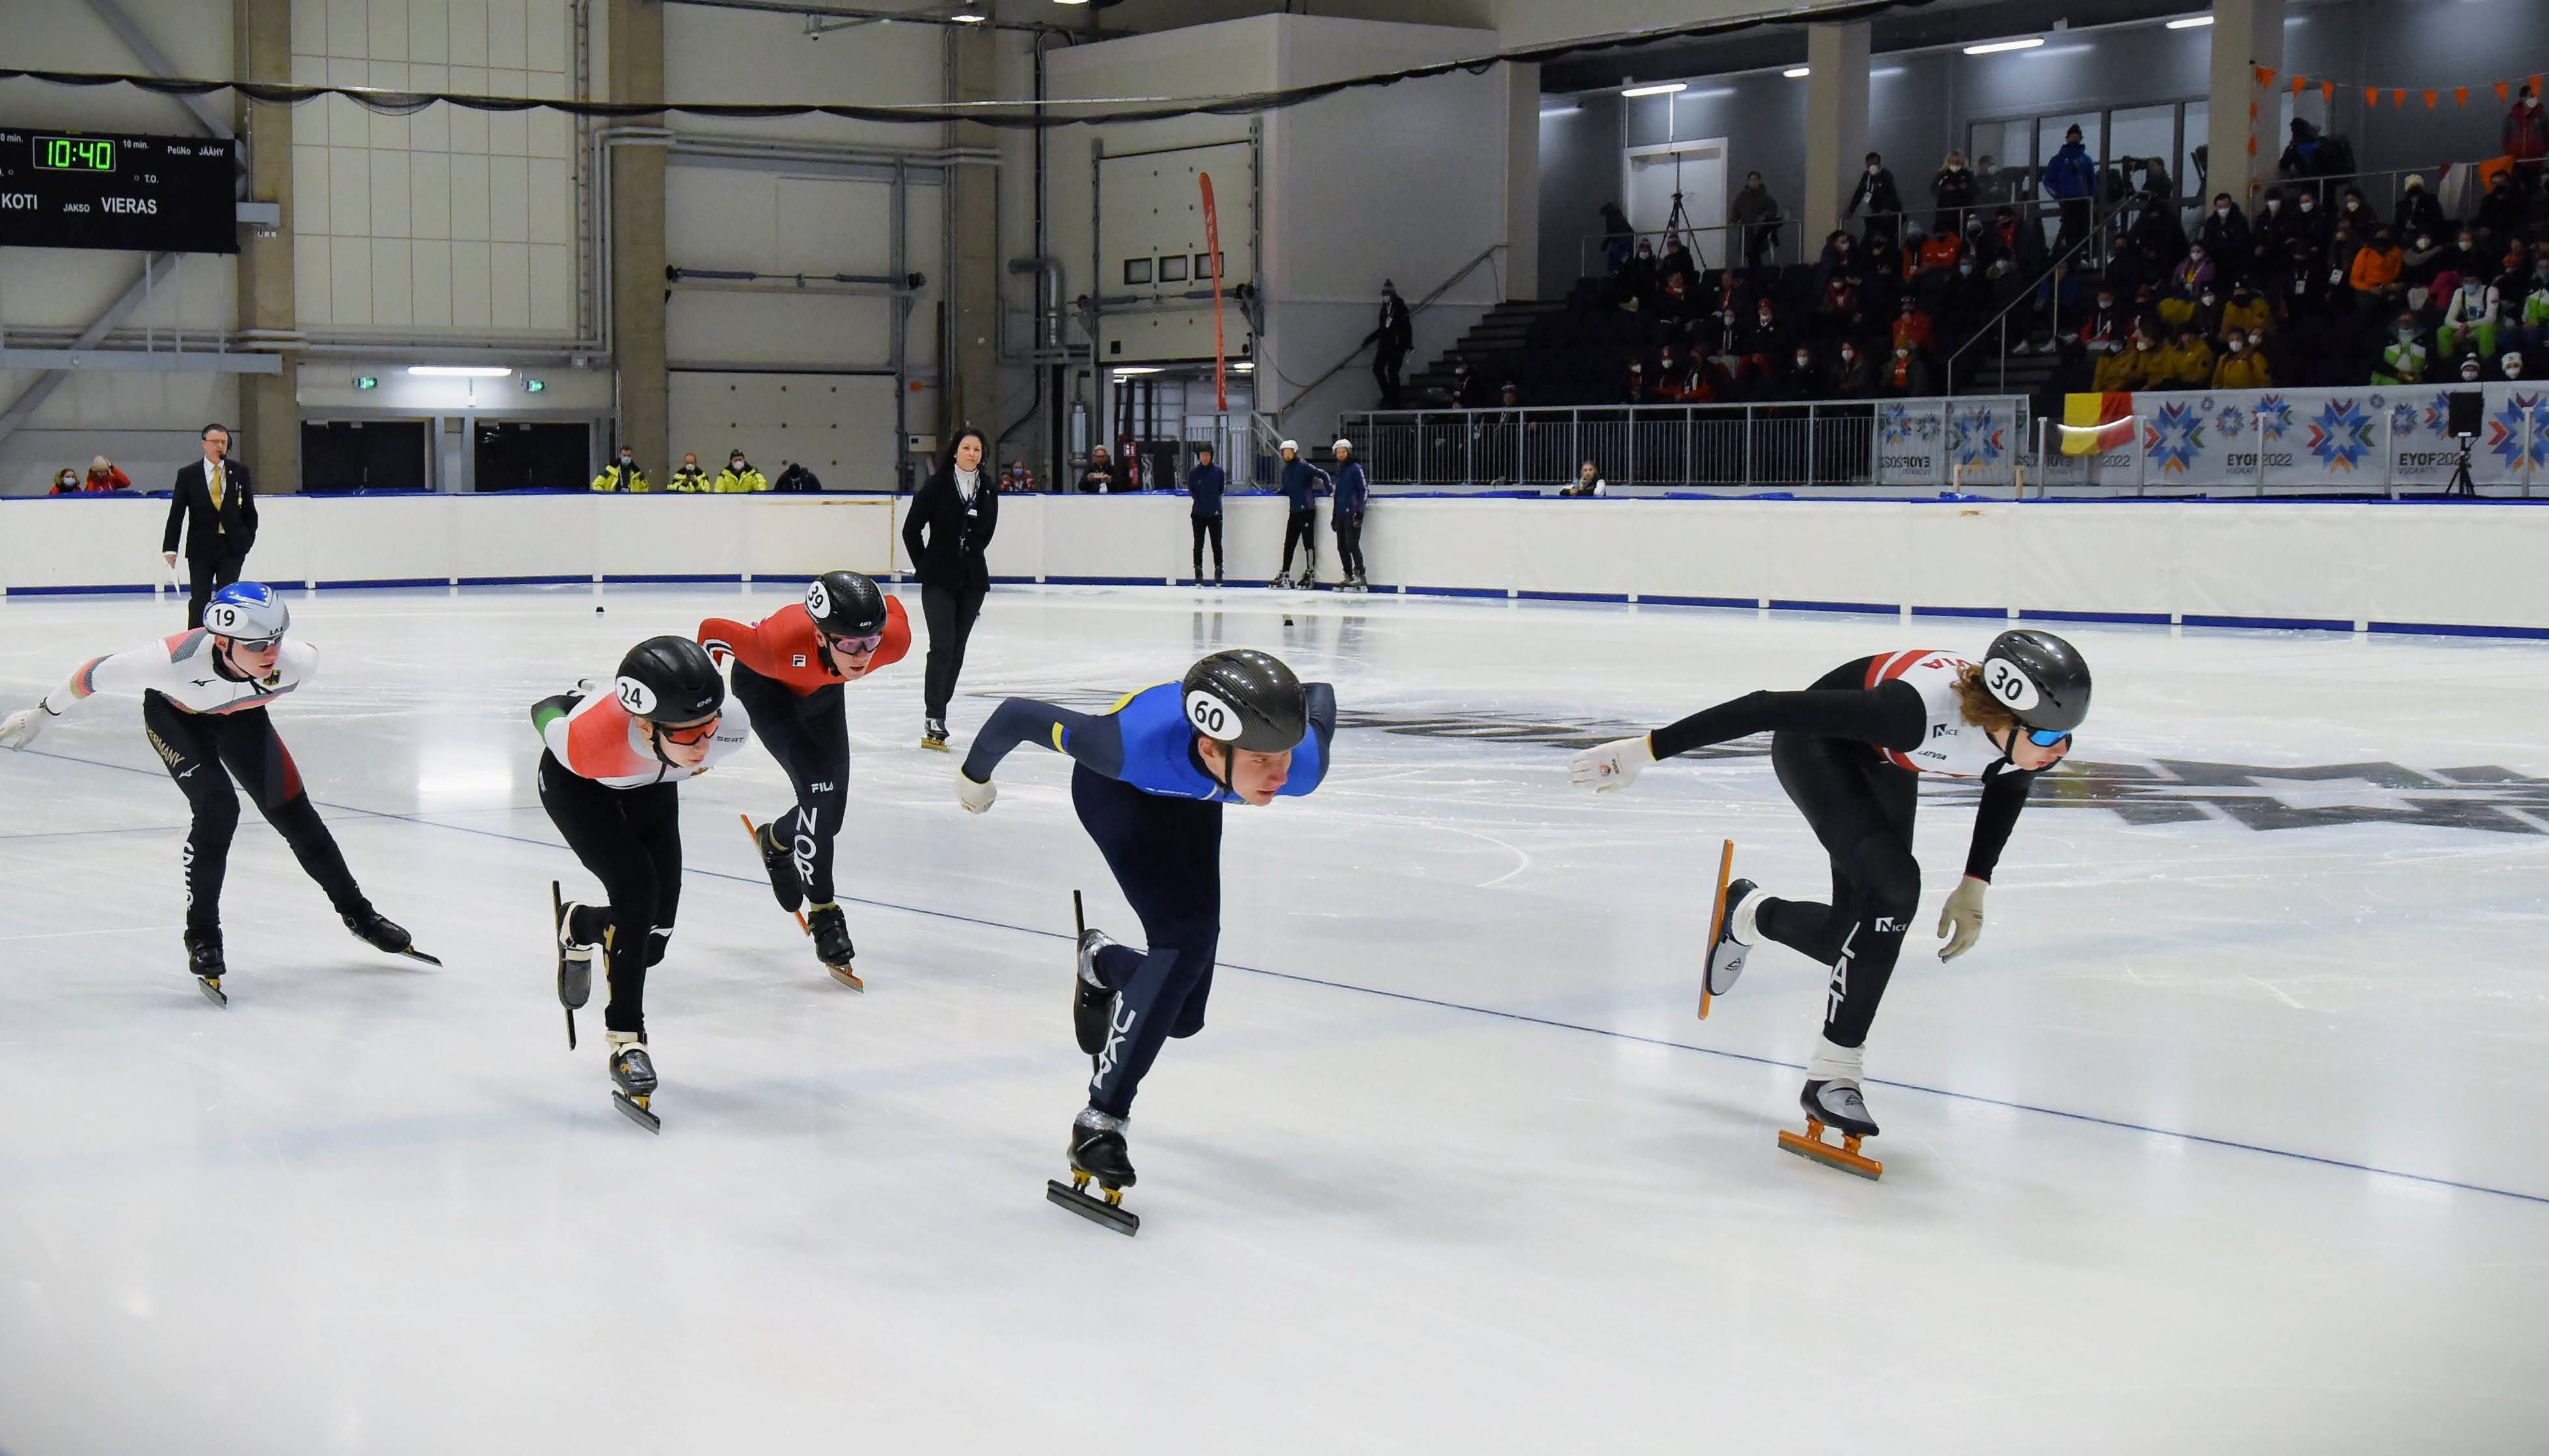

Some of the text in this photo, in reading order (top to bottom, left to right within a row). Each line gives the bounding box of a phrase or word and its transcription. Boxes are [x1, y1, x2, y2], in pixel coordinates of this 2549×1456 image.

[7, 134, 23, 142] min.
[123, 139, 149, 149] 10 min.
[48, 140, 111, 169] 10:40
[167, 146, 224, 156] PeliNo JÄÄHY
[145, 174, 159, 183] T.O.
[1, 193, 38, 210] KOTI
[63, 202, 90, 212] JAKSO
[101, 196, 157, 214] VIERAS
[808, 586, 824, 610] 39
[214, 608, 236, 627] 19
[1991, 666, 2023, 701] 30
[621, 682, 643, 709] 24
[1194, 700, 1224, 733] 60
[811, 781, 834, 794] FILA
[794, 805, 818, 886] NOR
[1829, 921, 1861, 1025] LAT
[1092, 990, 1137, 1090] UKR
